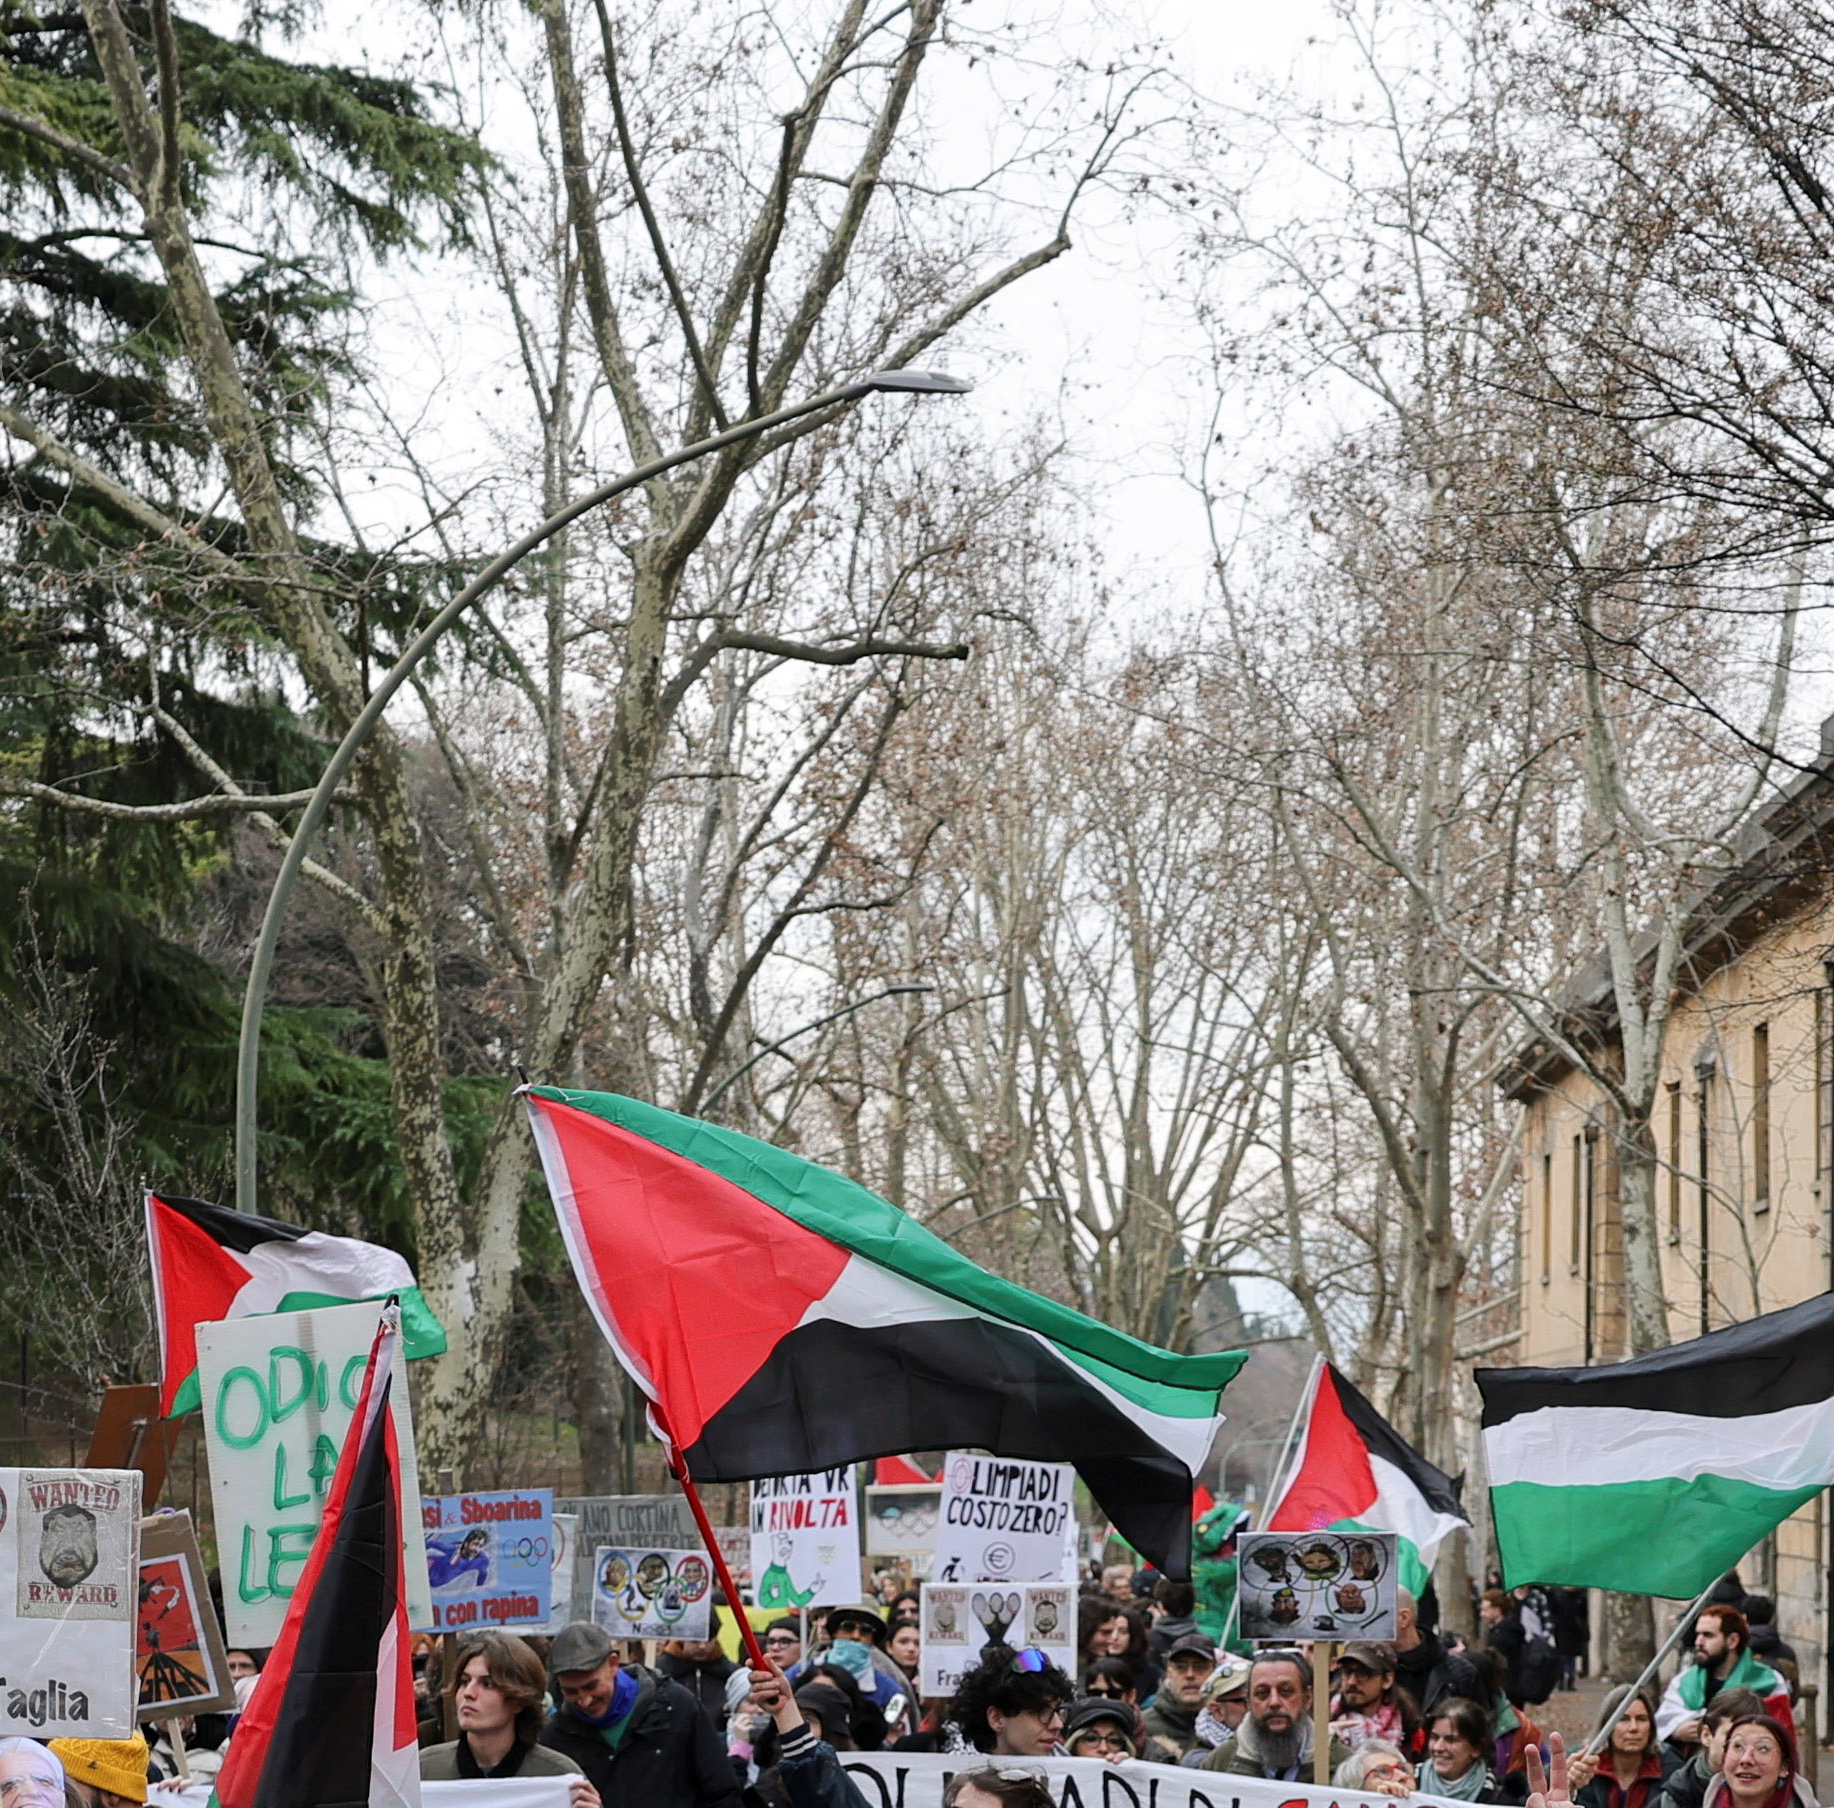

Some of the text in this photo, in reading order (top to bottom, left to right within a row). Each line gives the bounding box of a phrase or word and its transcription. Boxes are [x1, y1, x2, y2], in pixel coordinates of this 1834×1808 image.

[28, 1480, 121, 1512] WANTED
[460, 1494, 543, 1526] Sboarina
[769, 1498, 848, 1532] RIVOLTA
[28, 1582, 118, 1604] REWARD
[445, 1601, 477, 1627] con
[481, 1590, 539, 1625] rapina
